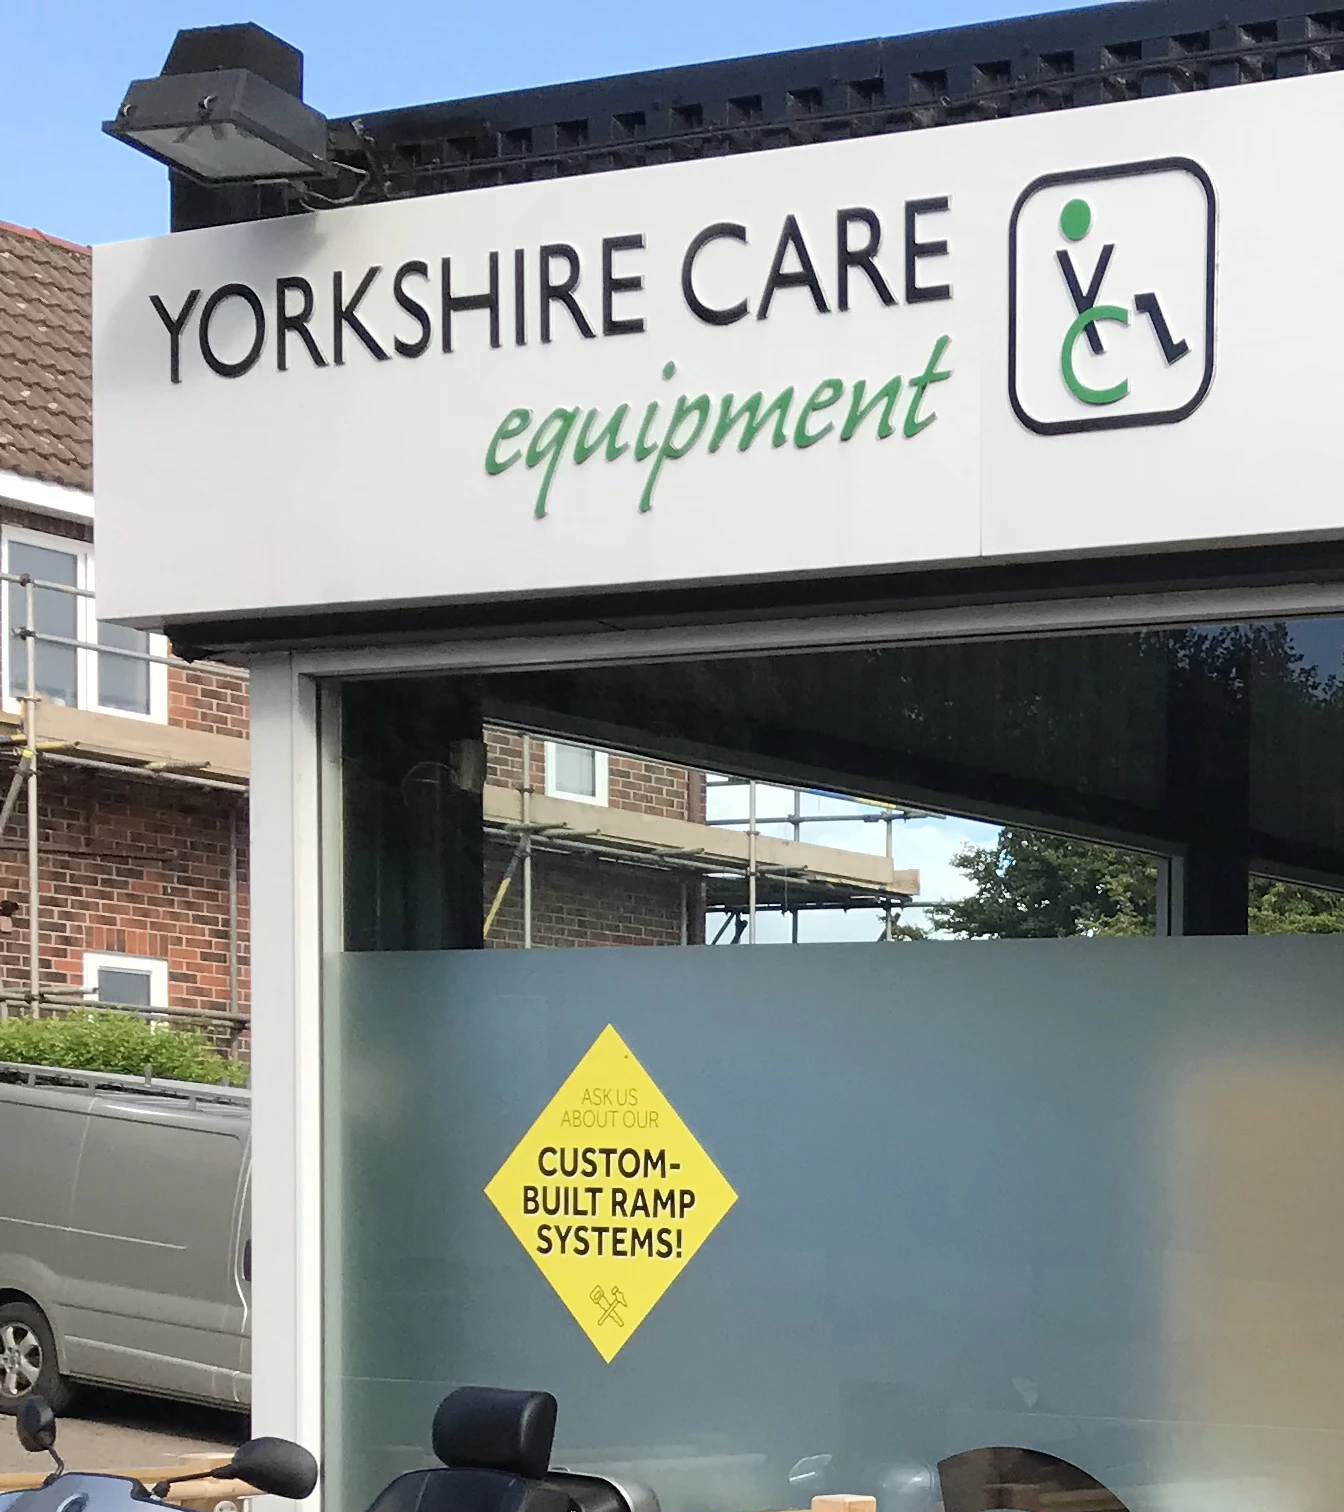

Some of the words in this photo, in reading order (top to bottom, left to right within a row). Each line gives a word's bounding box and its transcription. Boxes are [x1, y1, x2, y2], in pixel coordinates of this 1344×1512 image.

[149, 233, 647, 386] YORKSHIRE
[680, 195, 954, 327] CARE
[483, 334, 954, 520] equipment
[581, 1088, 612, 1106] ASK
[616, 1088, 638, 1107] US
[560, 1109, 619, 1129] ABOUT
[622, 1110, 659, 1129] OUR
[538, 1146, 681, 1179] CUSTOM-
[523, 1185, 602, 1216] BUILT
[611, 1187, 696, 1219] RAMP
[536, 1224, 683, 1259] SYSTEMS!
